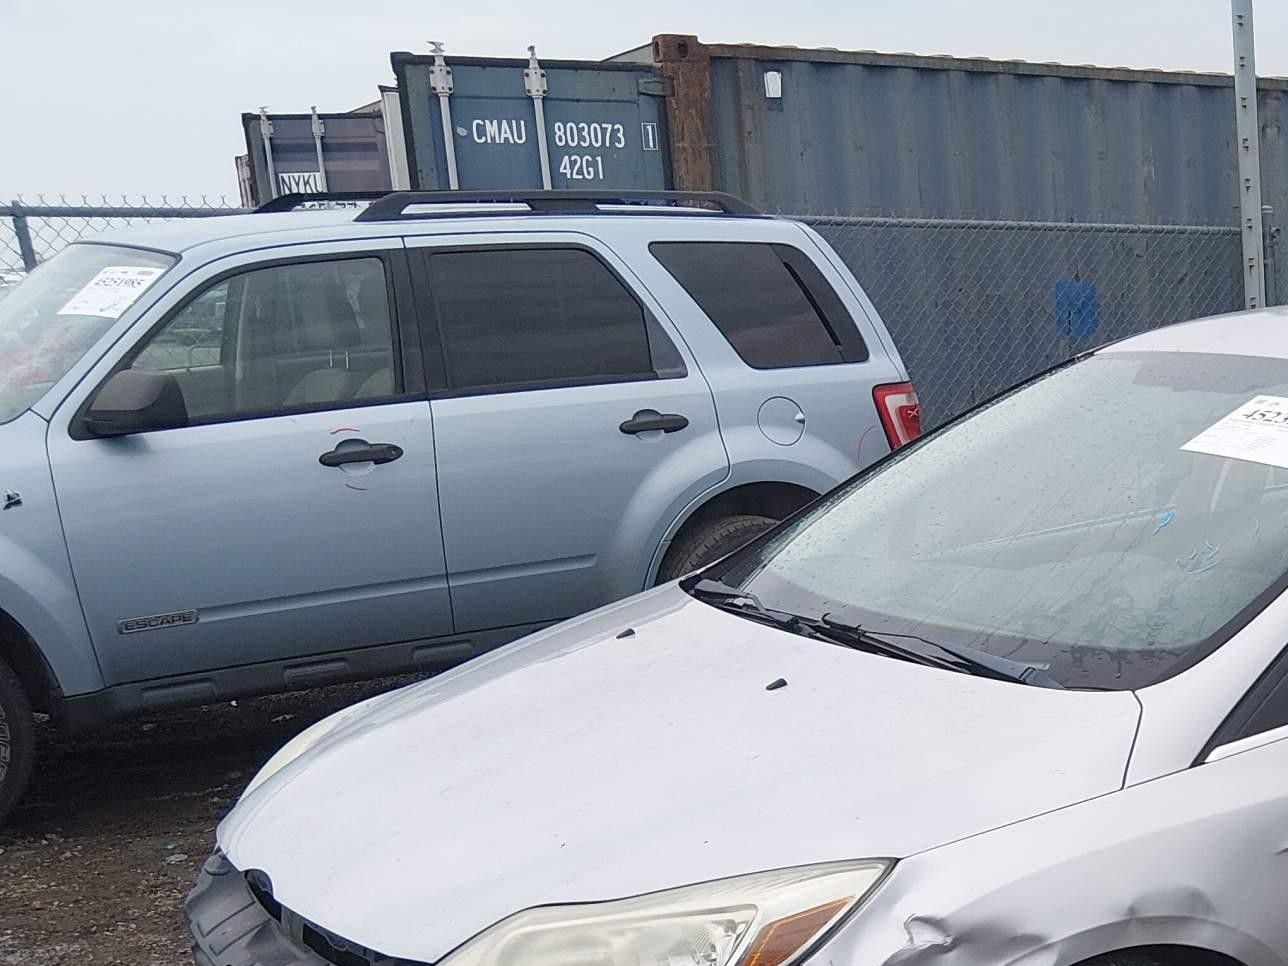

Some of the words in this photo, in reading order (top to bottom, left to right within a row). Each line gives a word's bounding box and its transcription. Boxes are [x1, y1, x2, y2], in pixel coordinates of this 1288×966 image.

[472, 119, 527, 144] CMAU
[554, 122, 626, 148] 803073
[644, 124, 655, 149] 1
[559, 155, 604, 179] 42G1
[280, 173, 323, 195] NYKU
[125, 613, 193, 631] ESCAPE
